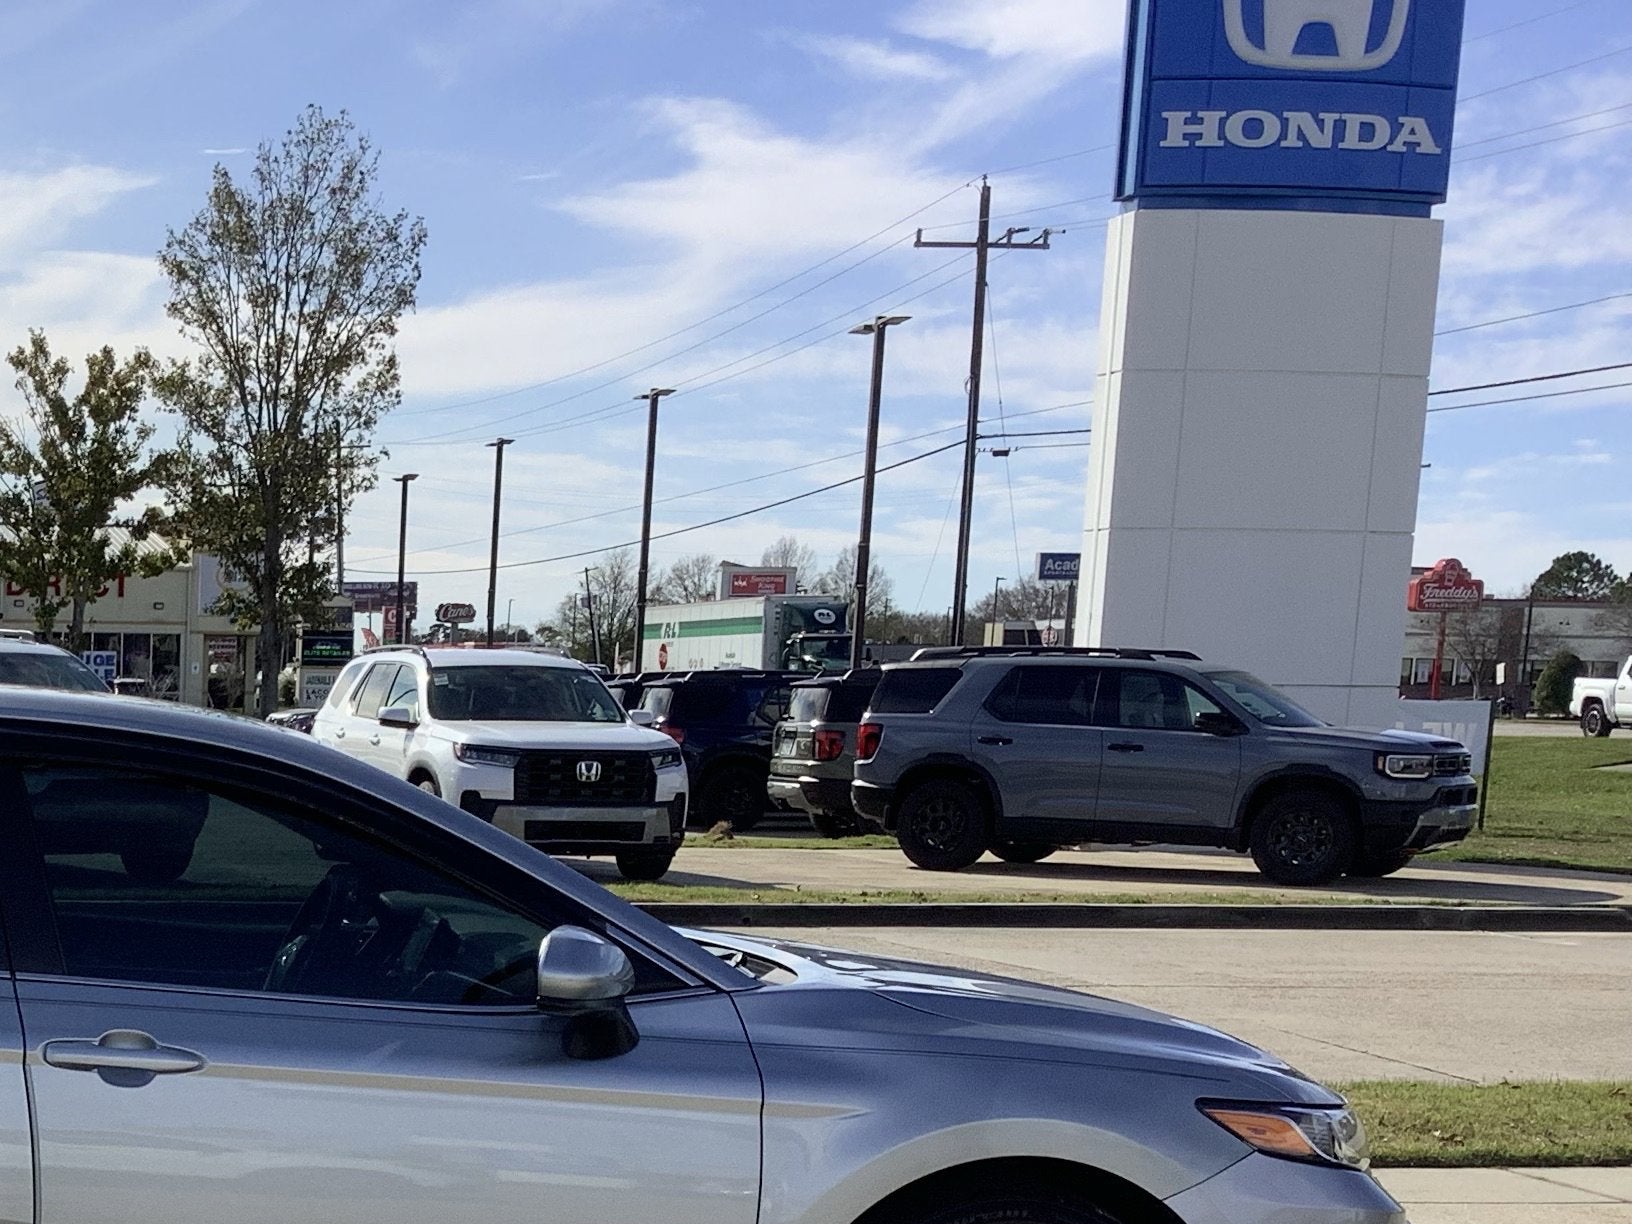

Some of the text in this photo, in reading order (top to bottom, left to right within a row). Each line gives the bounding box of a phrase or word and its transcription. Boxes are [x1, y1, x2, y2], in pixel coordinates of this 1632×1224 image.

[1159, 109, 1442, 154] HONDA
[1044, 558, 1079, 571] Acad
[1420, 583, 1479, 600] Freddy's
[81, 653, 115, 666] UGE
